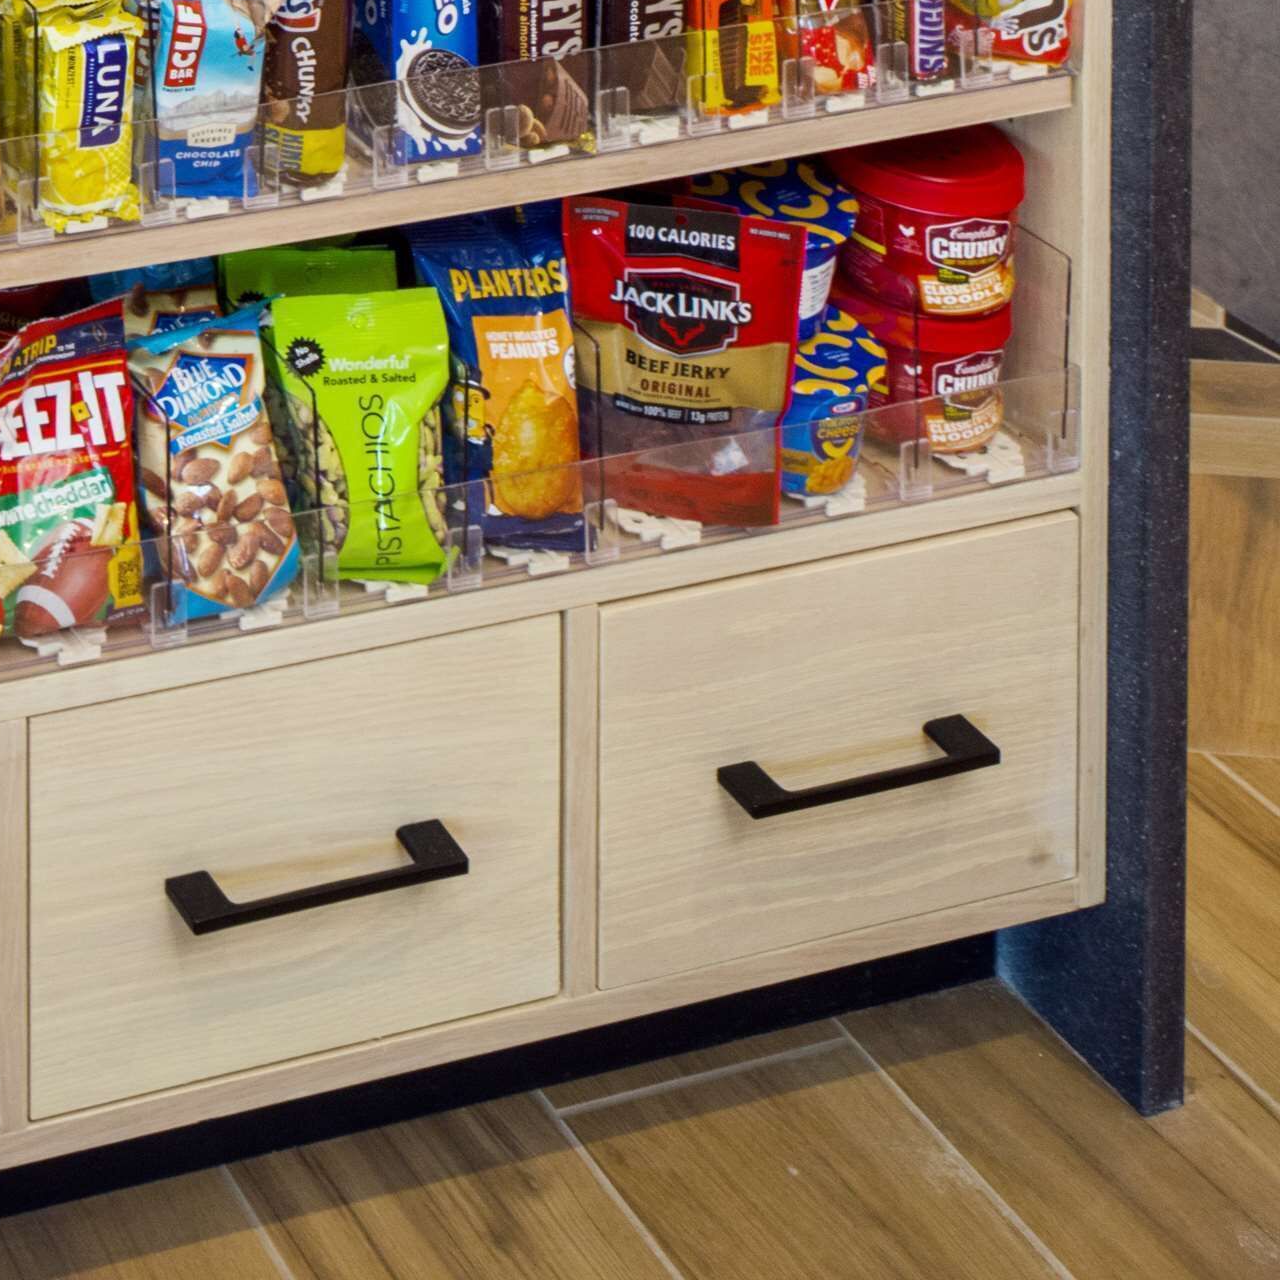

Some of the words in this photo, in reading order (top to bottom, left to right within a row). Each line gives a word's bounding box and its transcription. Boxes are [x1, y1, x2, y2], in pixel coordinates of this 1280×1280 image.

[171, 3, 204, 68] CLIF
[169, 69, 193, 80] BAR
[291, 36, 317, 124] CHUNKY
[91, 43, 121, 137] LUNA
[175, 150, 240, 160] CHOCOLATE
[193, 160, 221, 168] CHIP
[628, 224, 655, 240] 100
[657, 227, 735, 251] CALORIES
[932, 236, 1006, 261] CHUNKY
[448, 258, 568, 302] PLANTERS
[610, 280, 676, 318] JACK
[678, 293, 752, 325] LINK'S
[22, 334, 58, 365] TRIP
[328, 355, 412, 373] Wonderful
[489, 338, 560, 360] PEANUTS
[172, 358, 216, 393] BLUE
[322, 375, 368, 387] Roasted
[370, 373, 379, 385] &
[381, 372, 417, 384] Salted
[625, 349, 669, 372] BEEF
[671, 362, 731, 380] JERKY
[156, 362, 247, 420] DIAMOND
[640, 378, 712, 399] ORIGINAL
[175, 420, 225, 449] Roasted
[358, 392, 403, 567] PISTACHIOS
